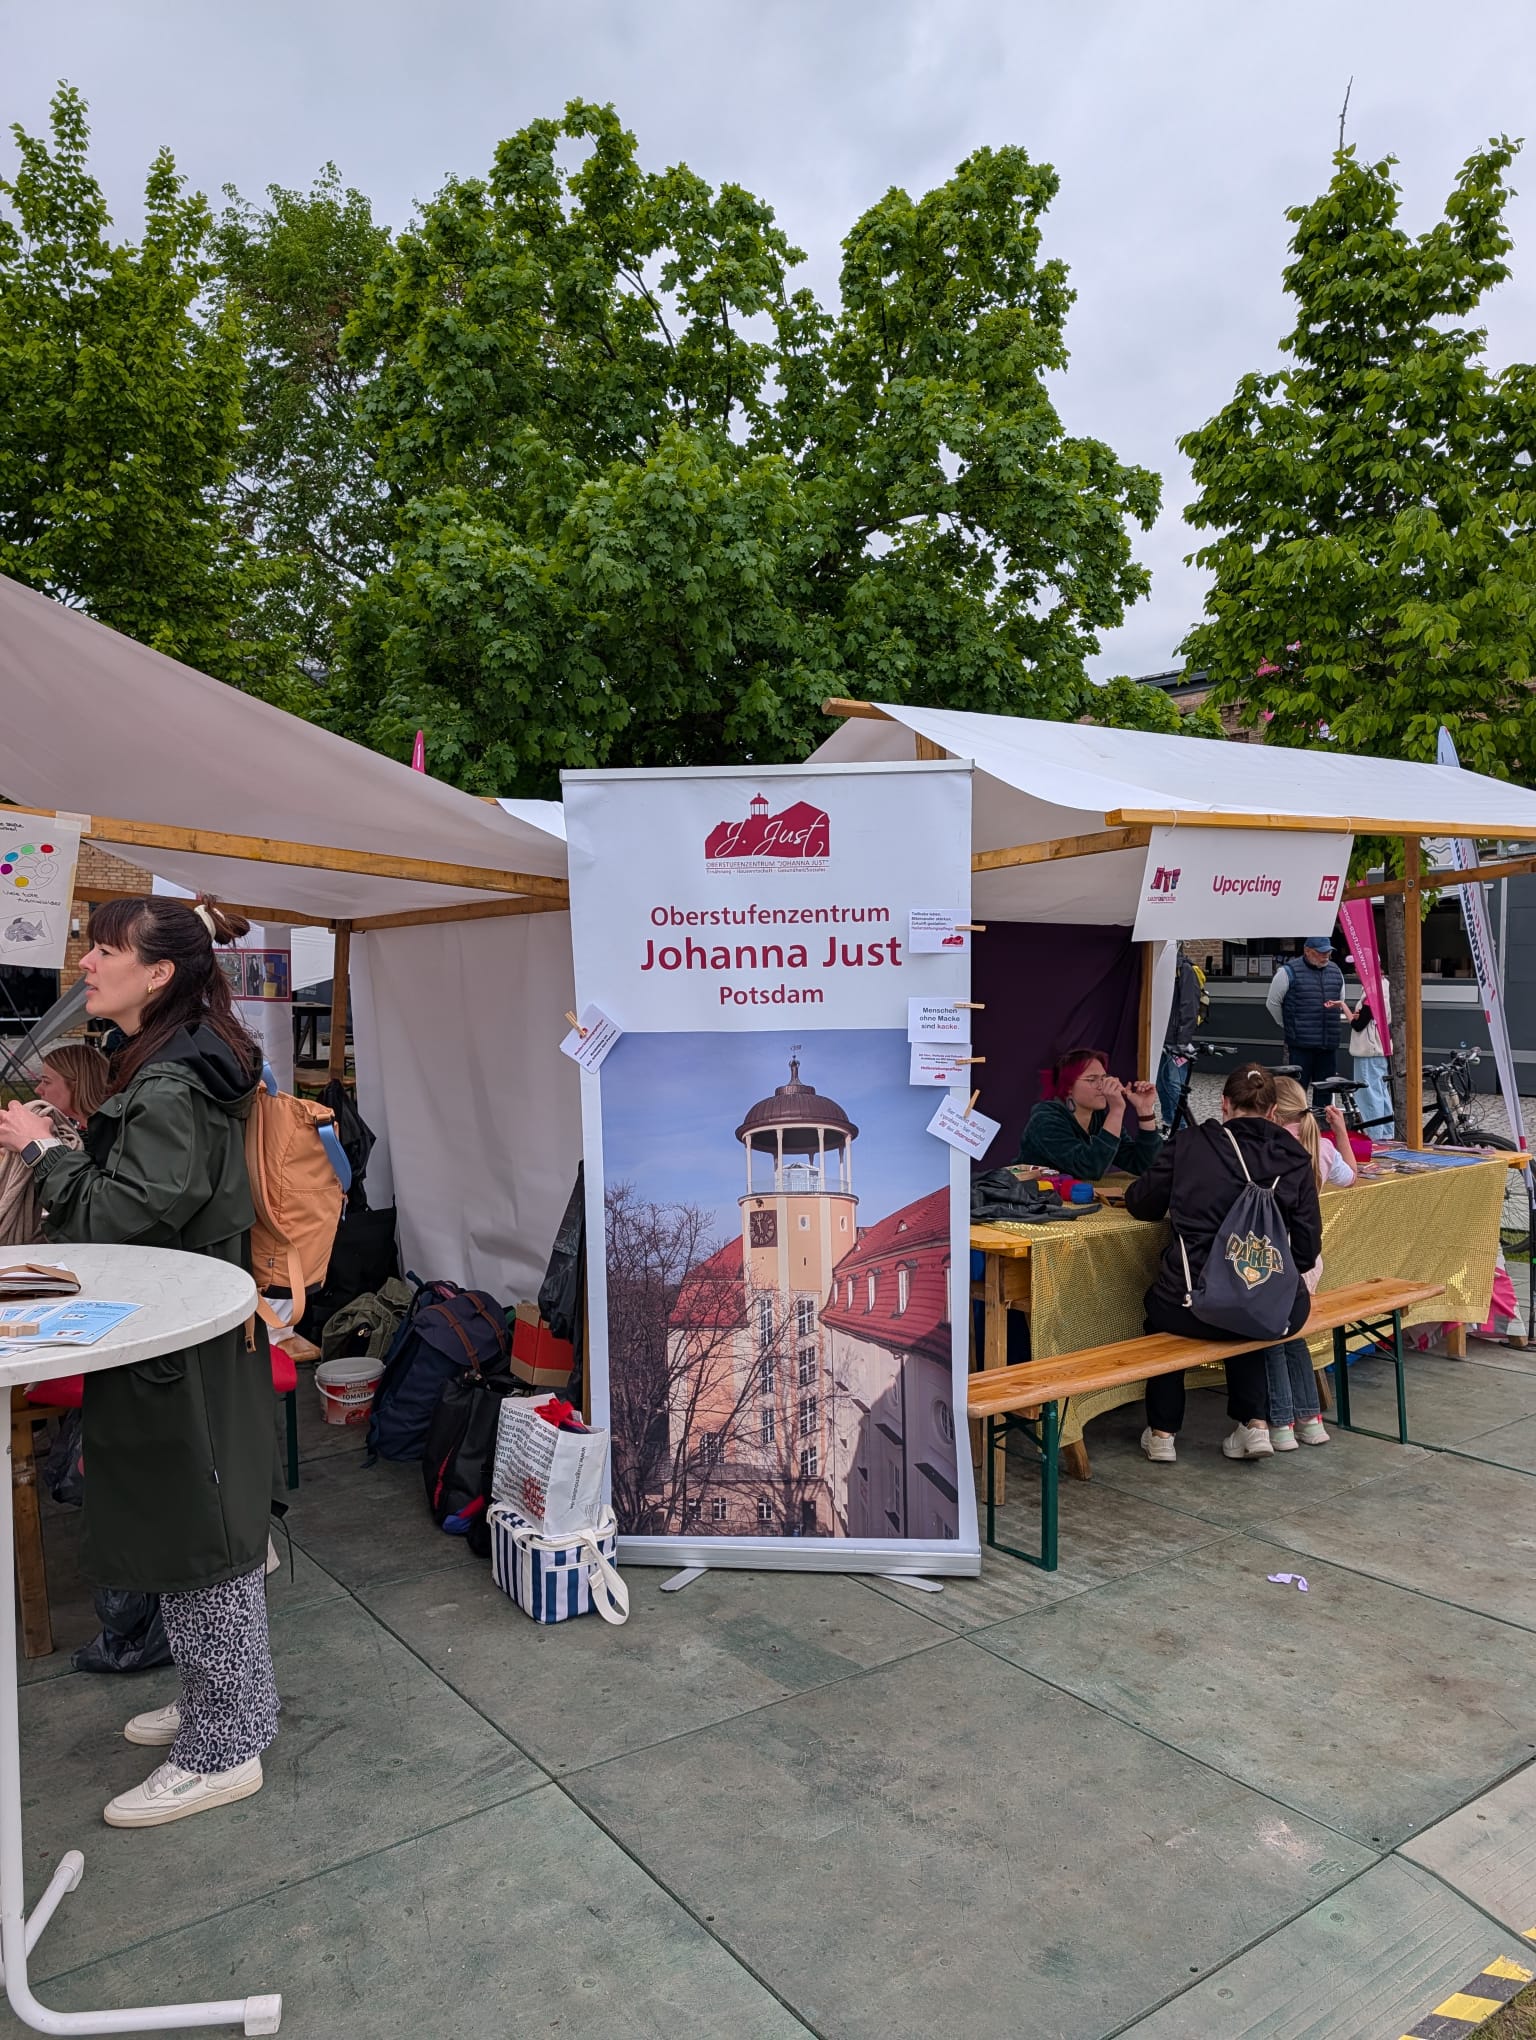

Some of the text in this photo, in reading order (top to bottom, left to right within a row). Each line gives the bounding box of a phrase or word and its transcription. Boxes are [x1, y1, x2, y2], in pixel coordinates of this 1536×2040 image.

[752, 812, 827, 858] Just
[1213, 874, 1282, 897] Upcycling
[1320, 880, 1337, 897] RZ
[650, 904, 891, 927] Oberstufenzentrum
[640, 936, 903, 971] Johanna Just
[720, 984, 824, 1005] Potsdam
